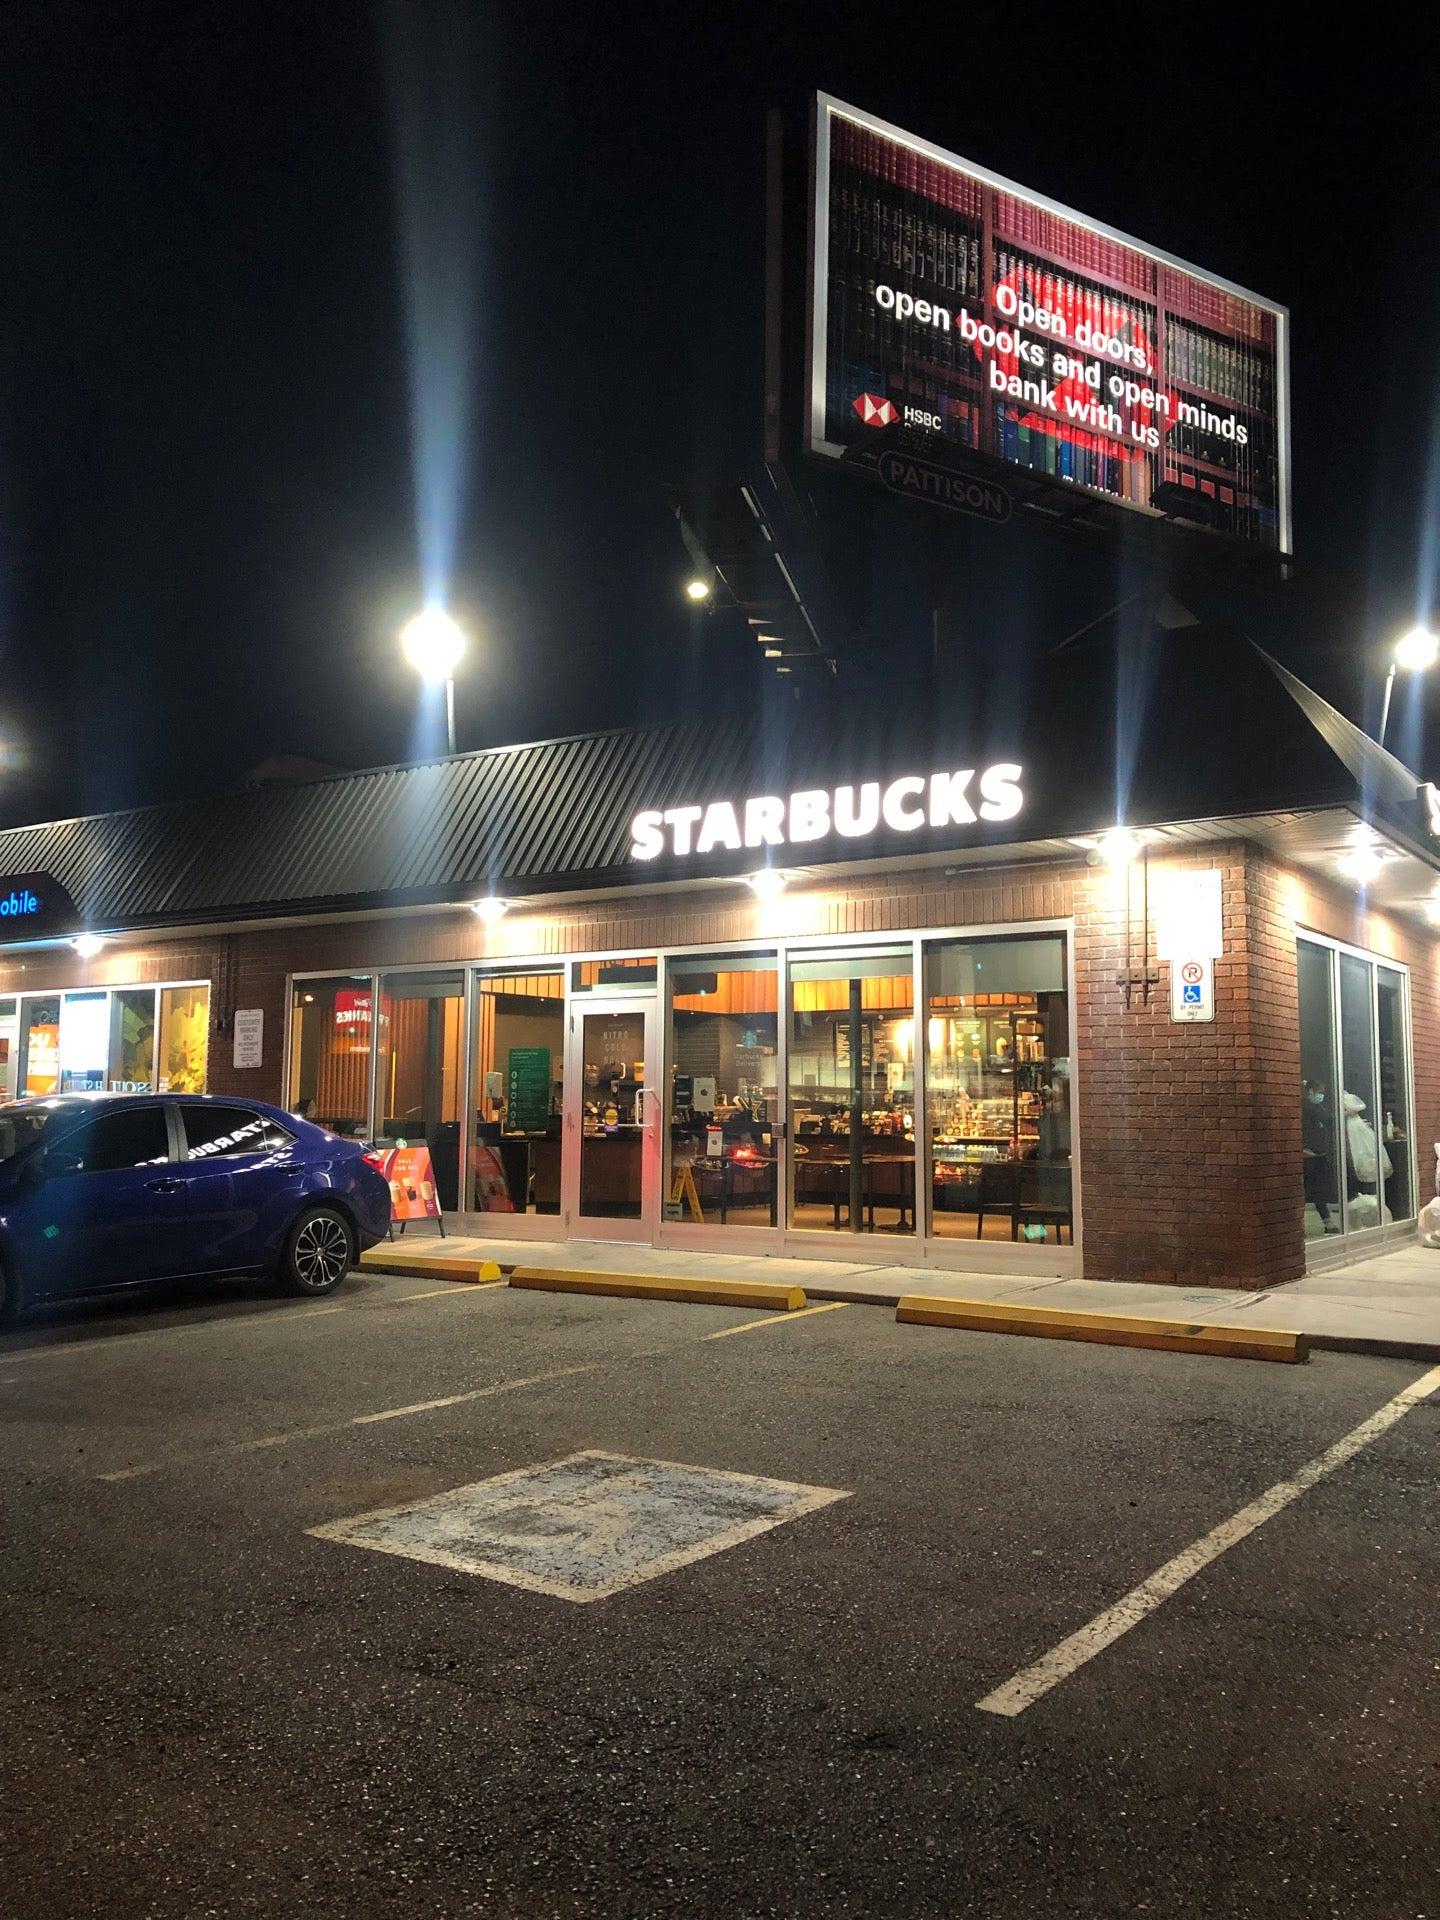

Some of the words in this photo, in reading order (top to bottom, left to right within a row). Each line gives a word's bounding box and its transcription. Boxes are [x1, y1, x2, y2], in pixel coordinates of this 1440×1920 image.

[875, 284, 951, 332] open
[960, 308, 1045, 367] books
[1052, 350, 1101, 389] and
[1109, 375, 1170, 416] open
[1177, 400, 1249, 445] minds
[996, 284, 1068, 338] Open
[1074, 320, 1154, 376] doors,
[904, 405, 942, 430] HSBC
[989, 360, 1058, 412] bank
[1063, 394, 1123, 435] with
[1131, 420, 1160, 448] us
[890, 461, 1001, 514] PATTISON
[630, 762, 1024, 860] STARBUCKS
